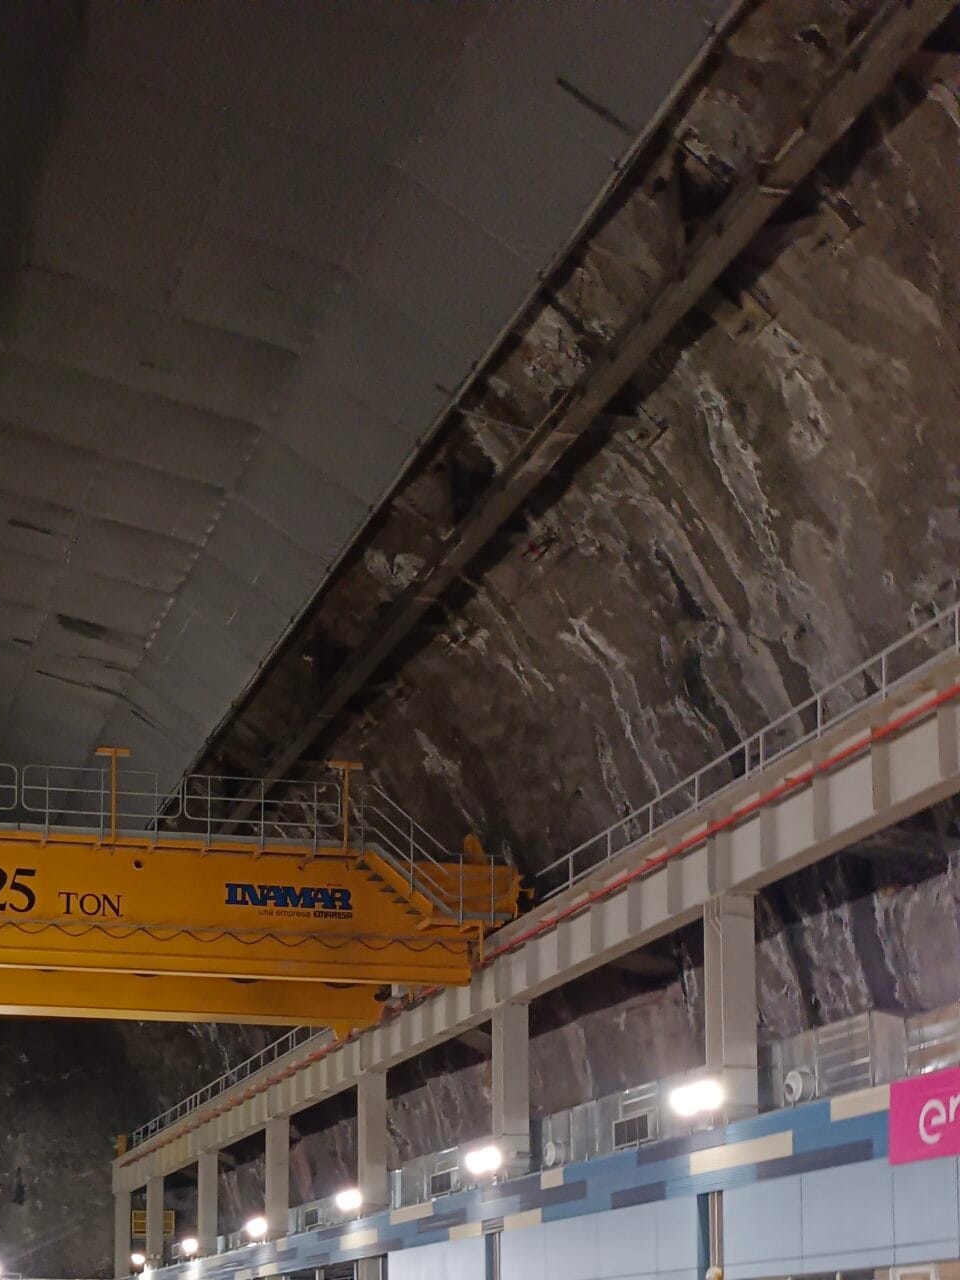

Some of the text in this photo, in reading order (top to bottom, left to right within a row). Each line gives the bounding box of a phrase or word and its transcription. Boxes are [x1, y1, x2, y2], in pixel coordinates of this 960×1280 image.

[57, 891, 123, 918] TON.
[224, 882, 353, 911] INAMAR
[275, 910, 311, 918] empresa
